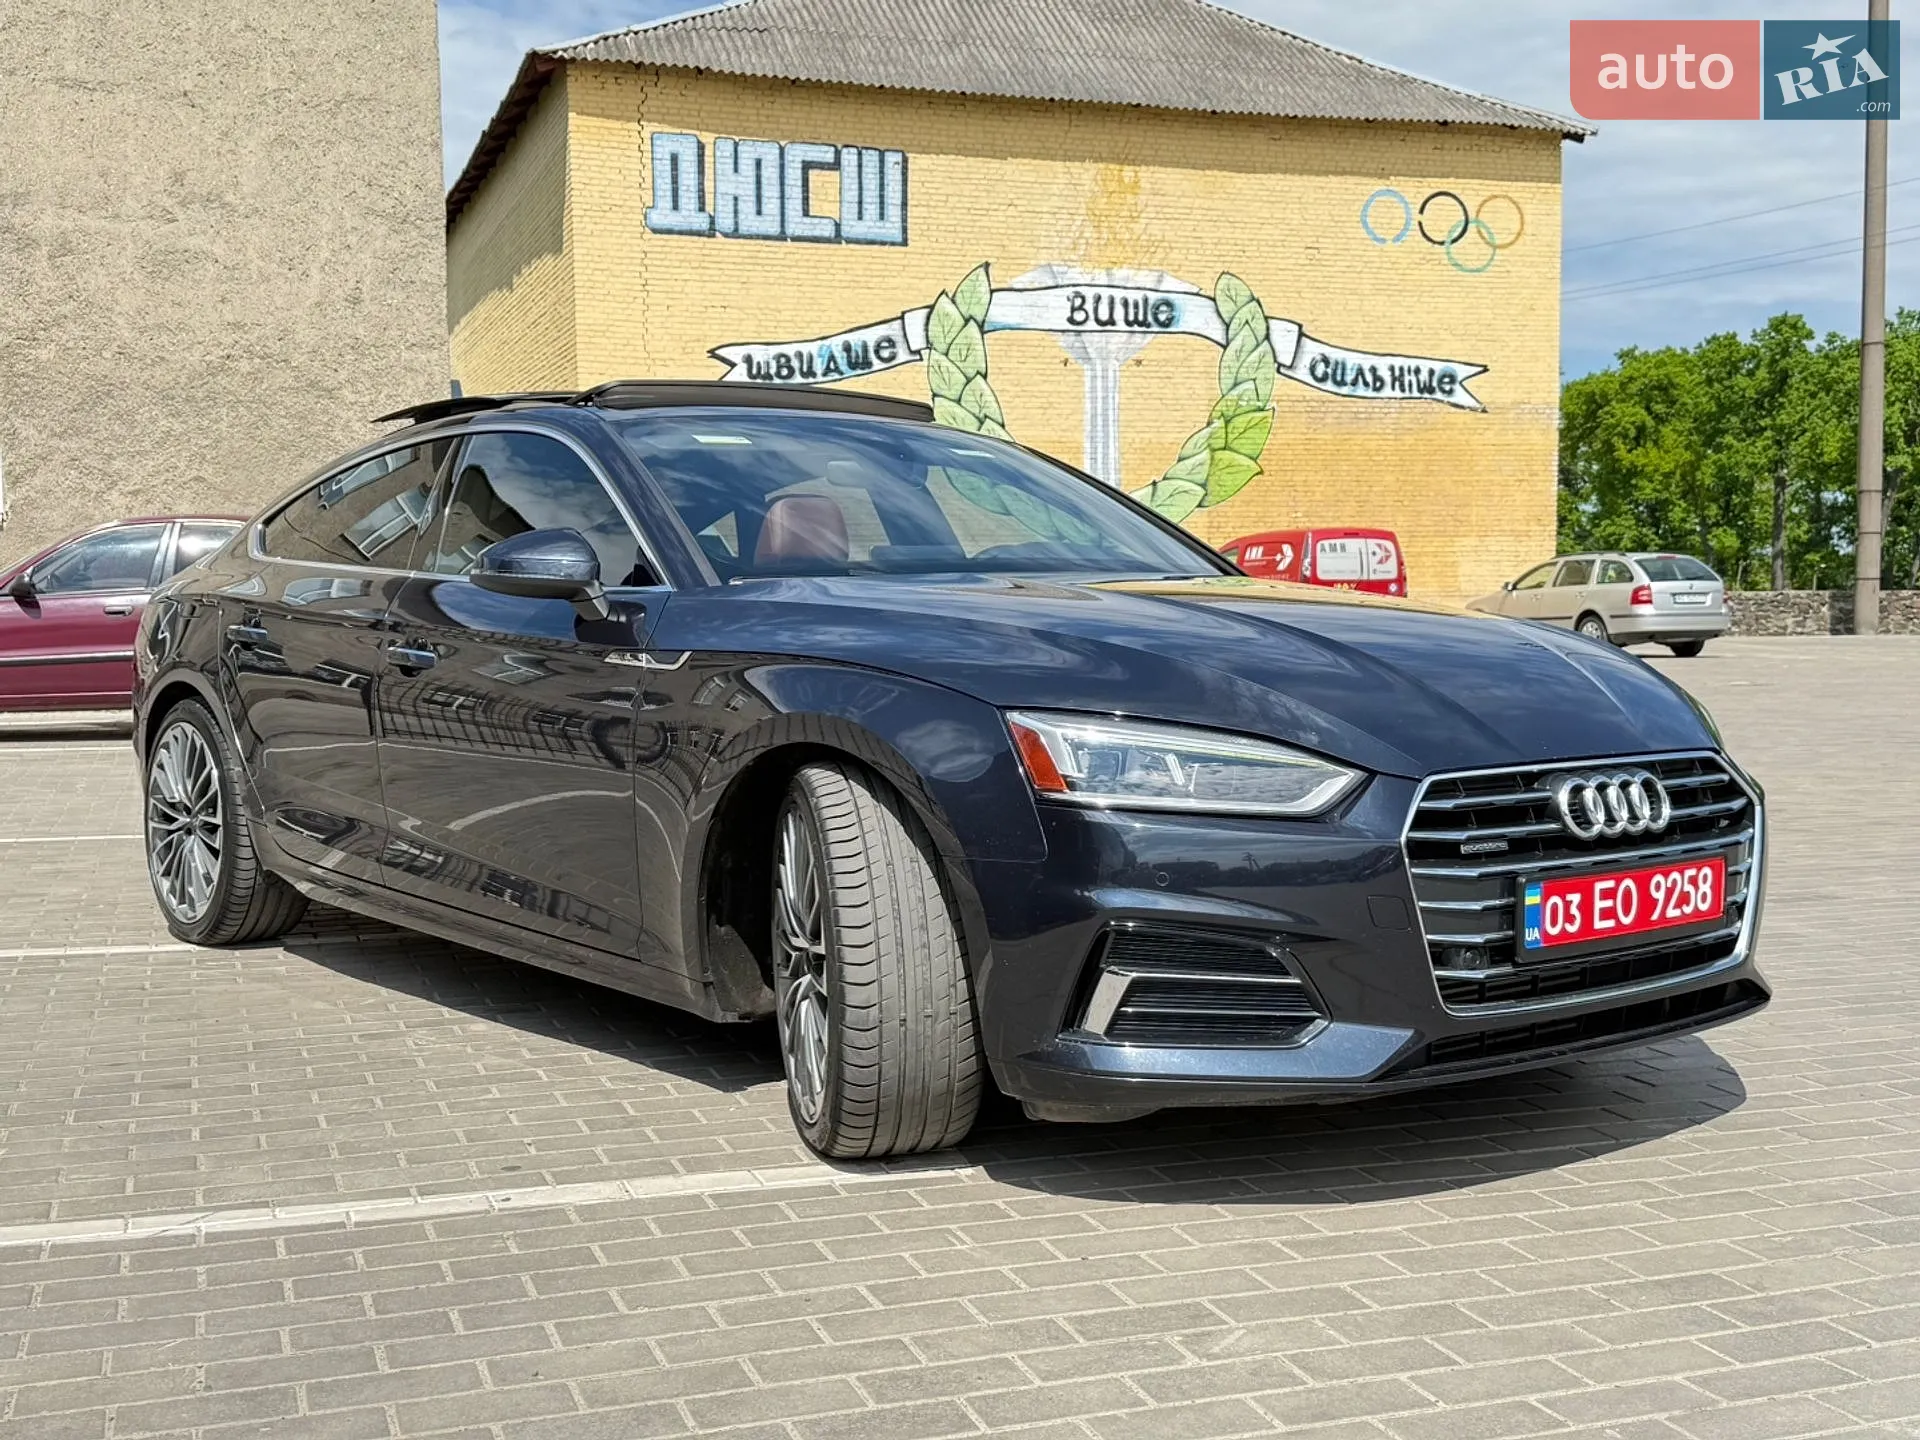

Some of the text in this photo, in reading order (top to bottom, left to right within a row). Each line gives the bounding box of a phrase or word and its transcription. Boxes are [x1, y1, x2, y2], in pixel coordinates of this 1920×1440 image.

[645, 131, 909, 246] ДЮСШ
[1525, 926, 1541, 941] UA
[1544, 893, 1582, 936] 03
[1649, 865, 1712, 921] 9258
